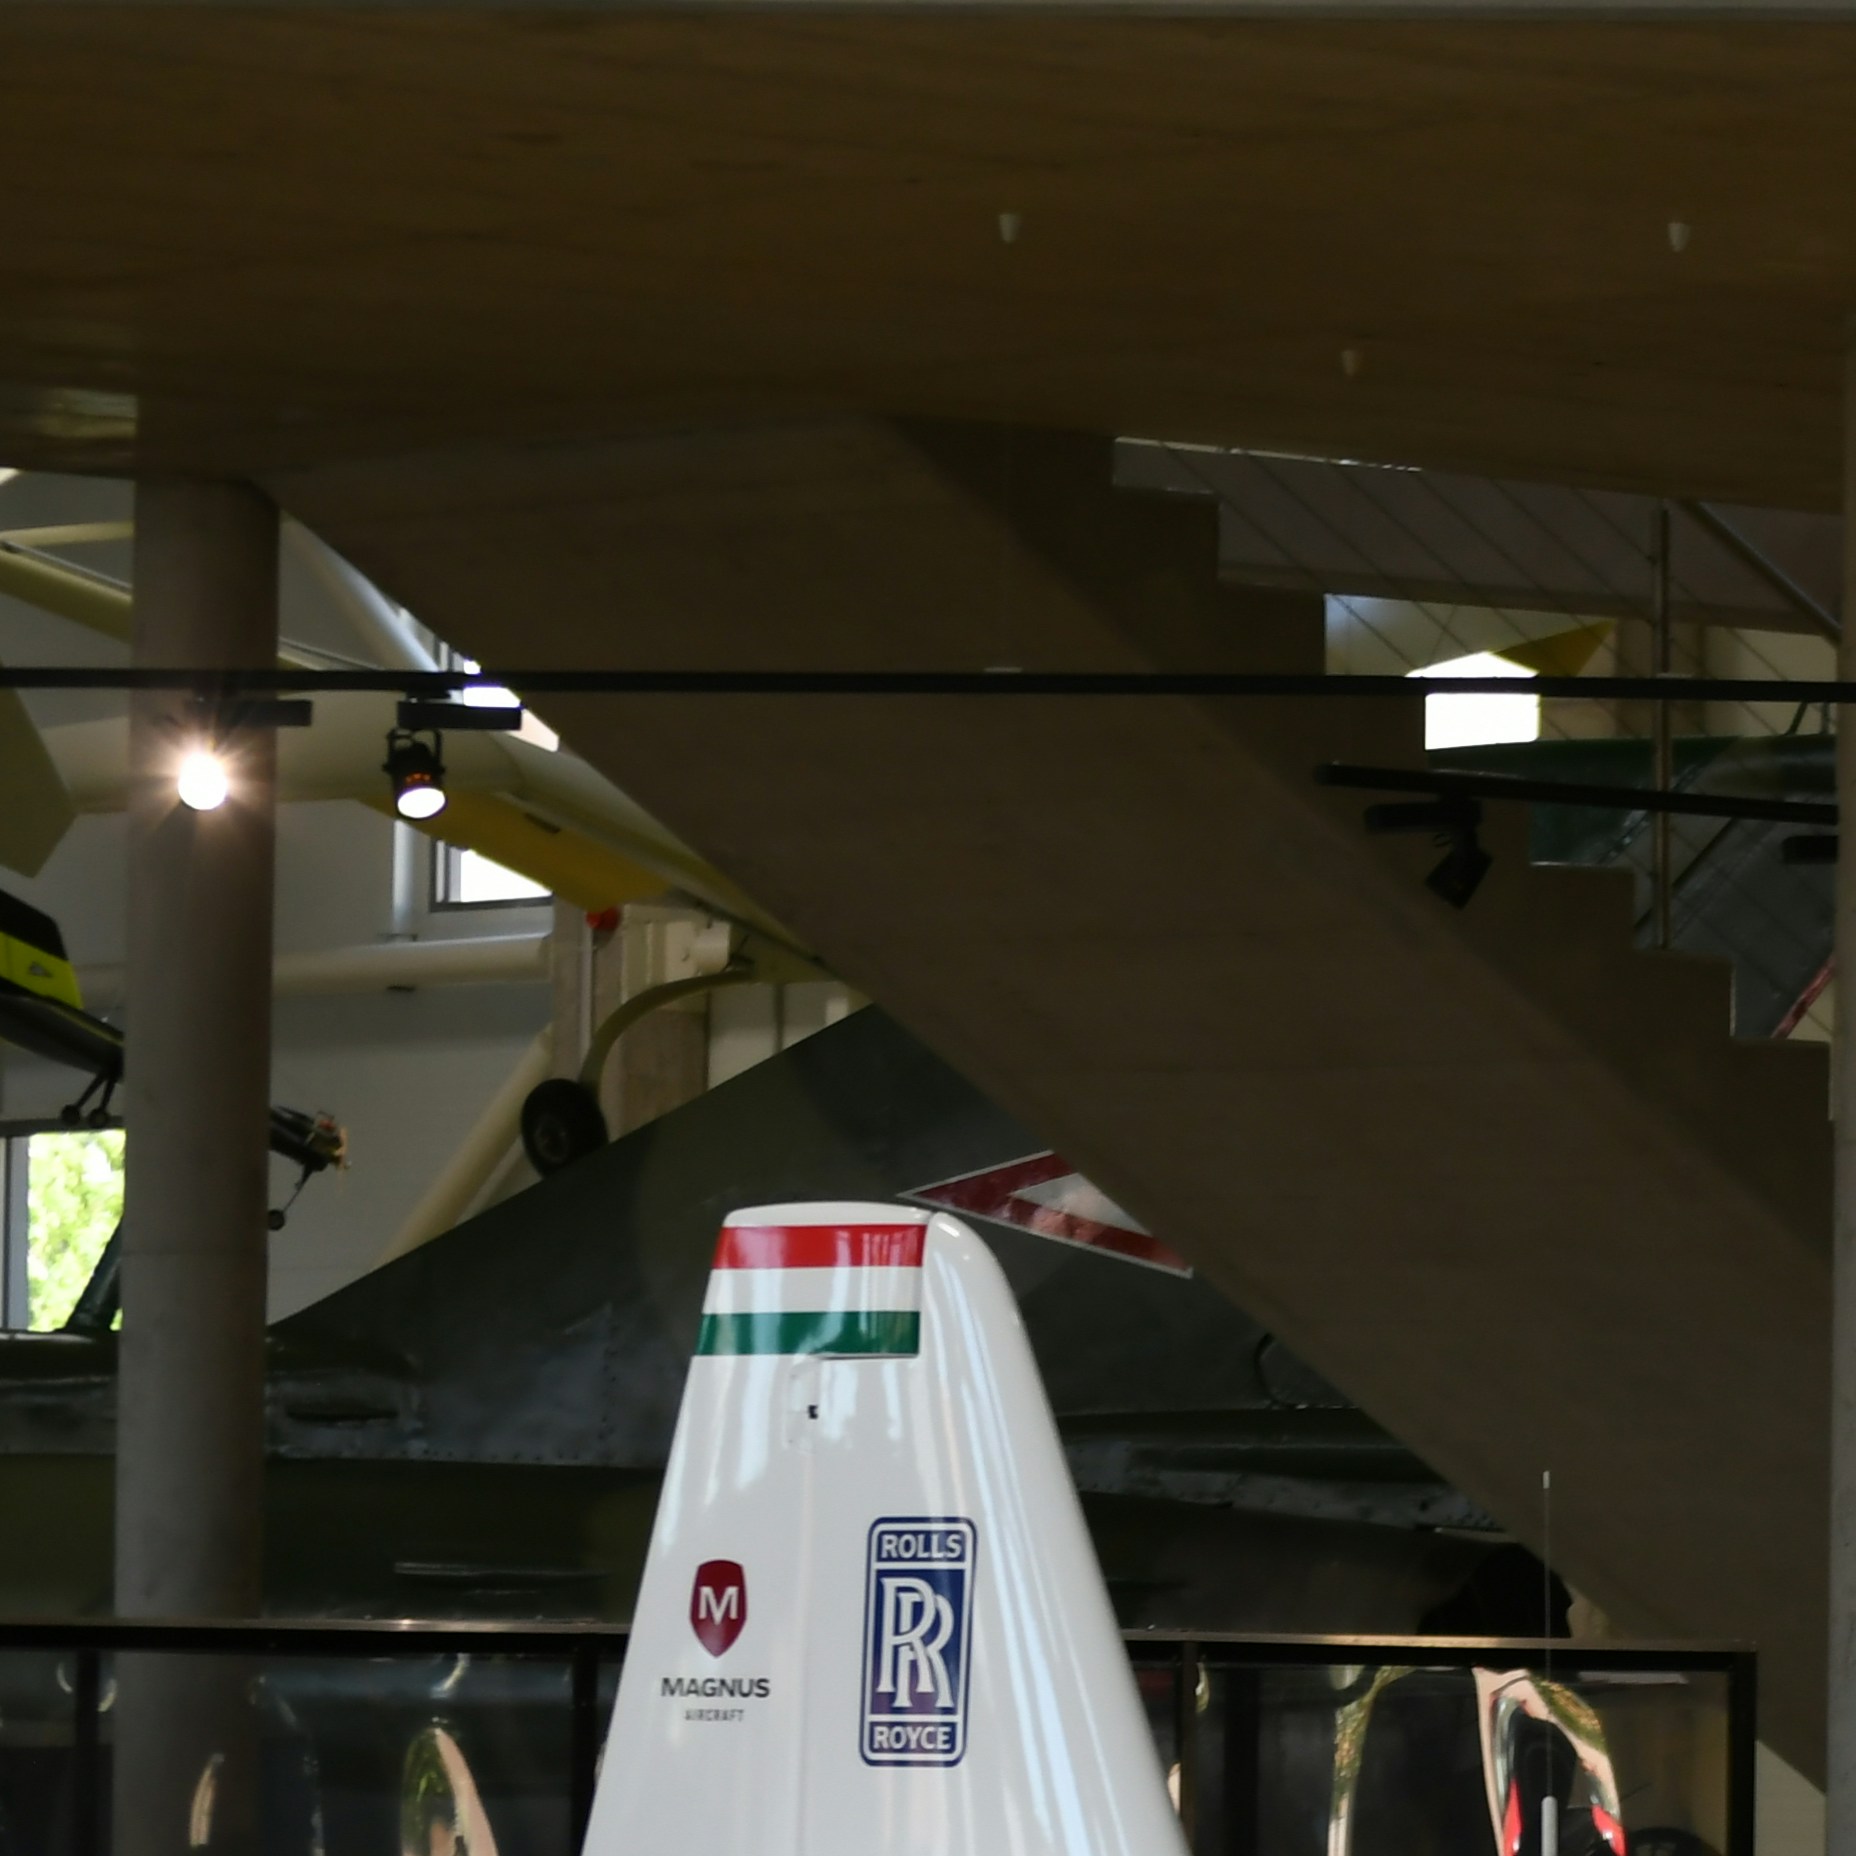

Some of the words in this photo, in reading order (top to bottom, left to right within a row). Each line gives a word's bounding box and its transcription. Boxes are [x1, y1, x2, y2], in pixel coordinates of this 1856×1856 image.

[880, 1532, 962, 1560] ROLLS
[698, 1584, 740, 1626] M
[660, 1677, 771, 1699] MAGNUS
[684, 1708, 744, 1722] AIRCRAFT
[872, 1725, 953, 1751] ROYCE
